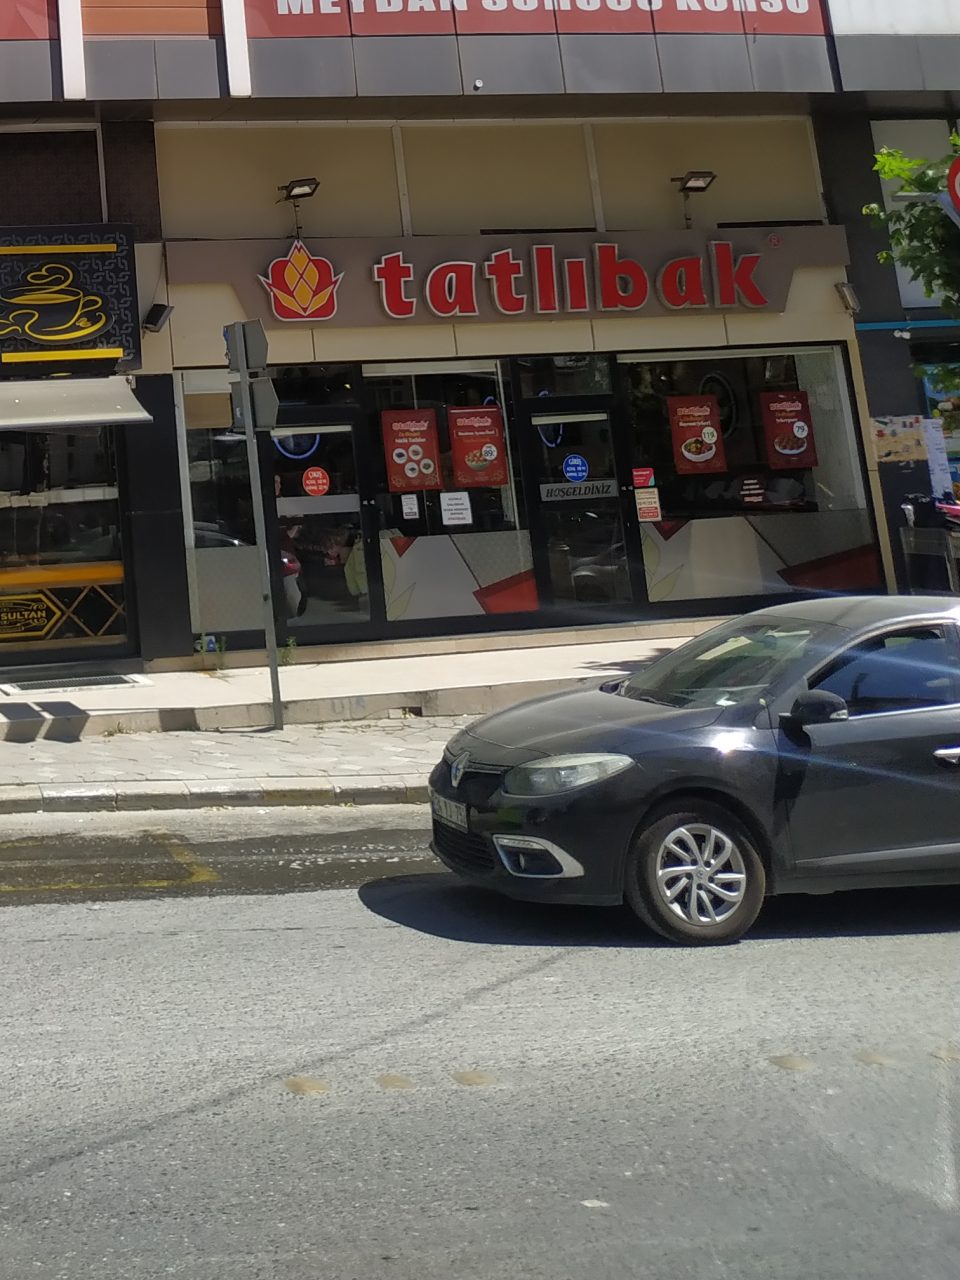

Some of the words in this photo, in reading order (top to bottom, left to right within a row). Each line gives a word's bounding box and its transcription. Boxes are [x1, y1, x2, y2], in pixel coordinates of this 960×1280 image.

[373, 239, 769, 318] tatlıbak
[545, 483, 612, 498] HOŞGELDİNİZ
[0, 610, 47, 621] SULTAN
